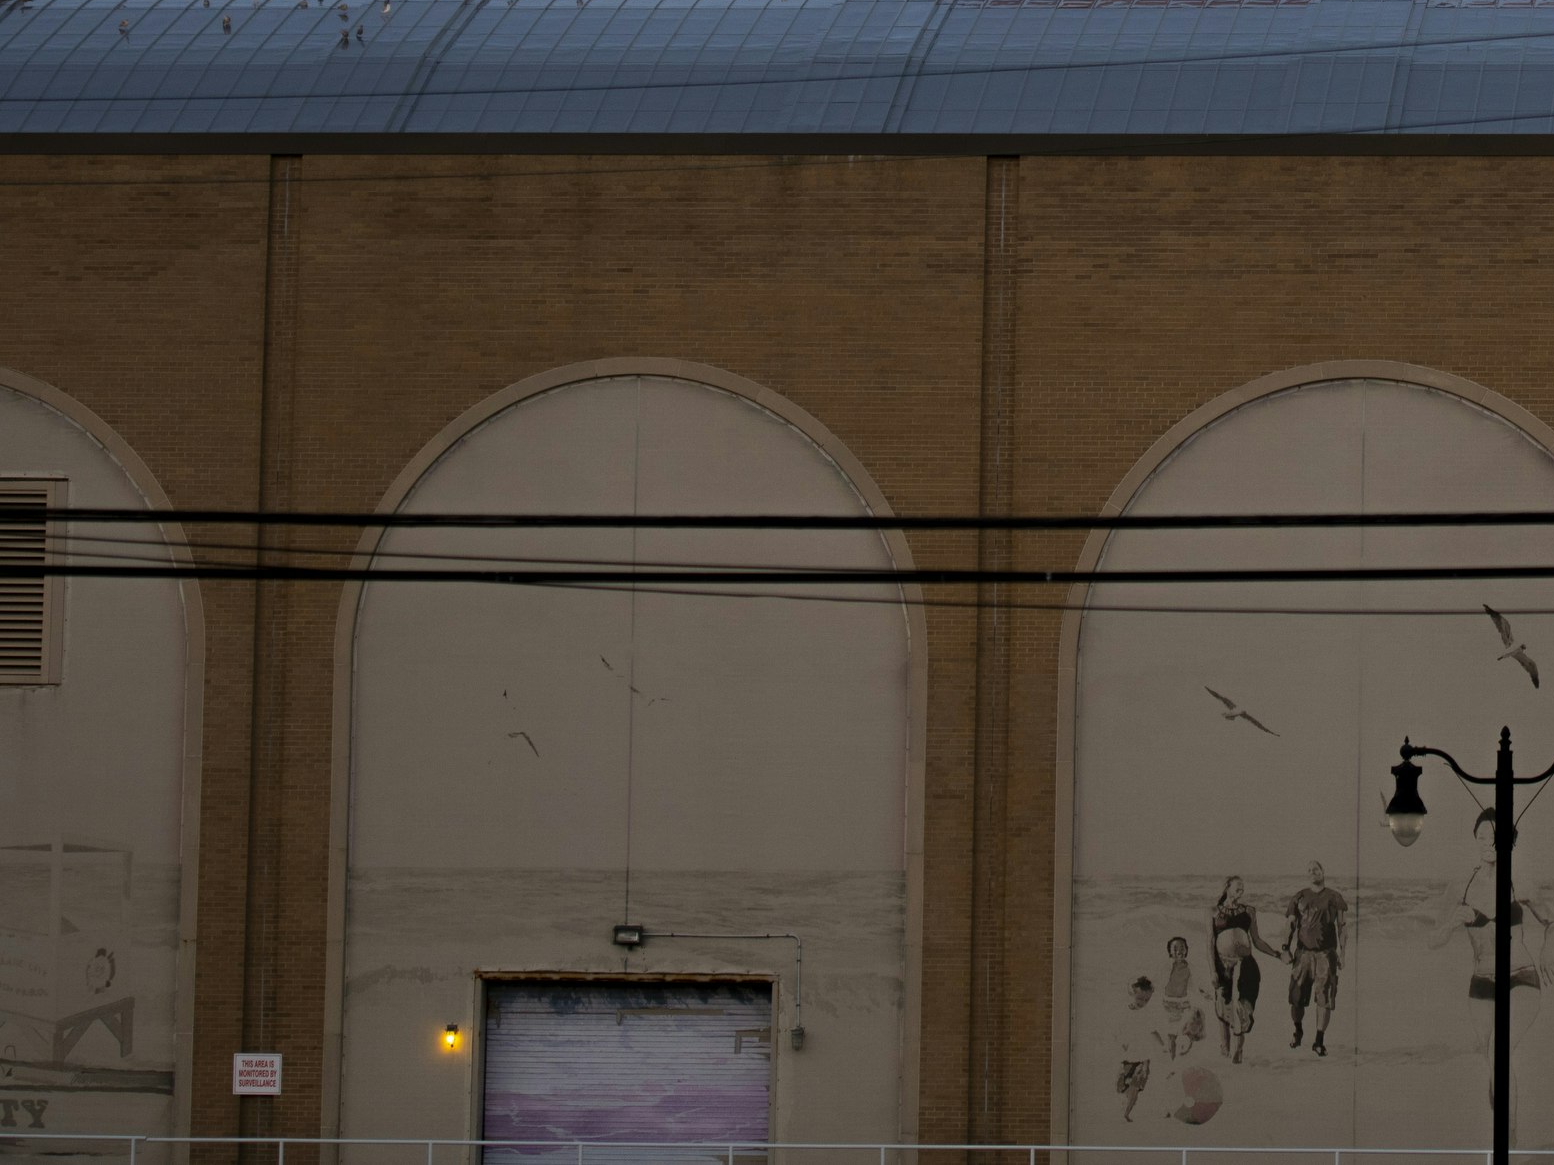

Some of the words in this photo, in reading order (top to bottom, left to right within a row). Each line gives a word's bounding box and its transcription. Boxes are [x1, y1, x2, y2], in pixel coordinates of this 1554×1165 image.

[241, 1060, 253, 1068] THIS
[255, 1060, 268, 1068] AREA
[269, 1060, 274, 1068] IS
[239, 1079, 276, 1087] SURVEILLANCE
